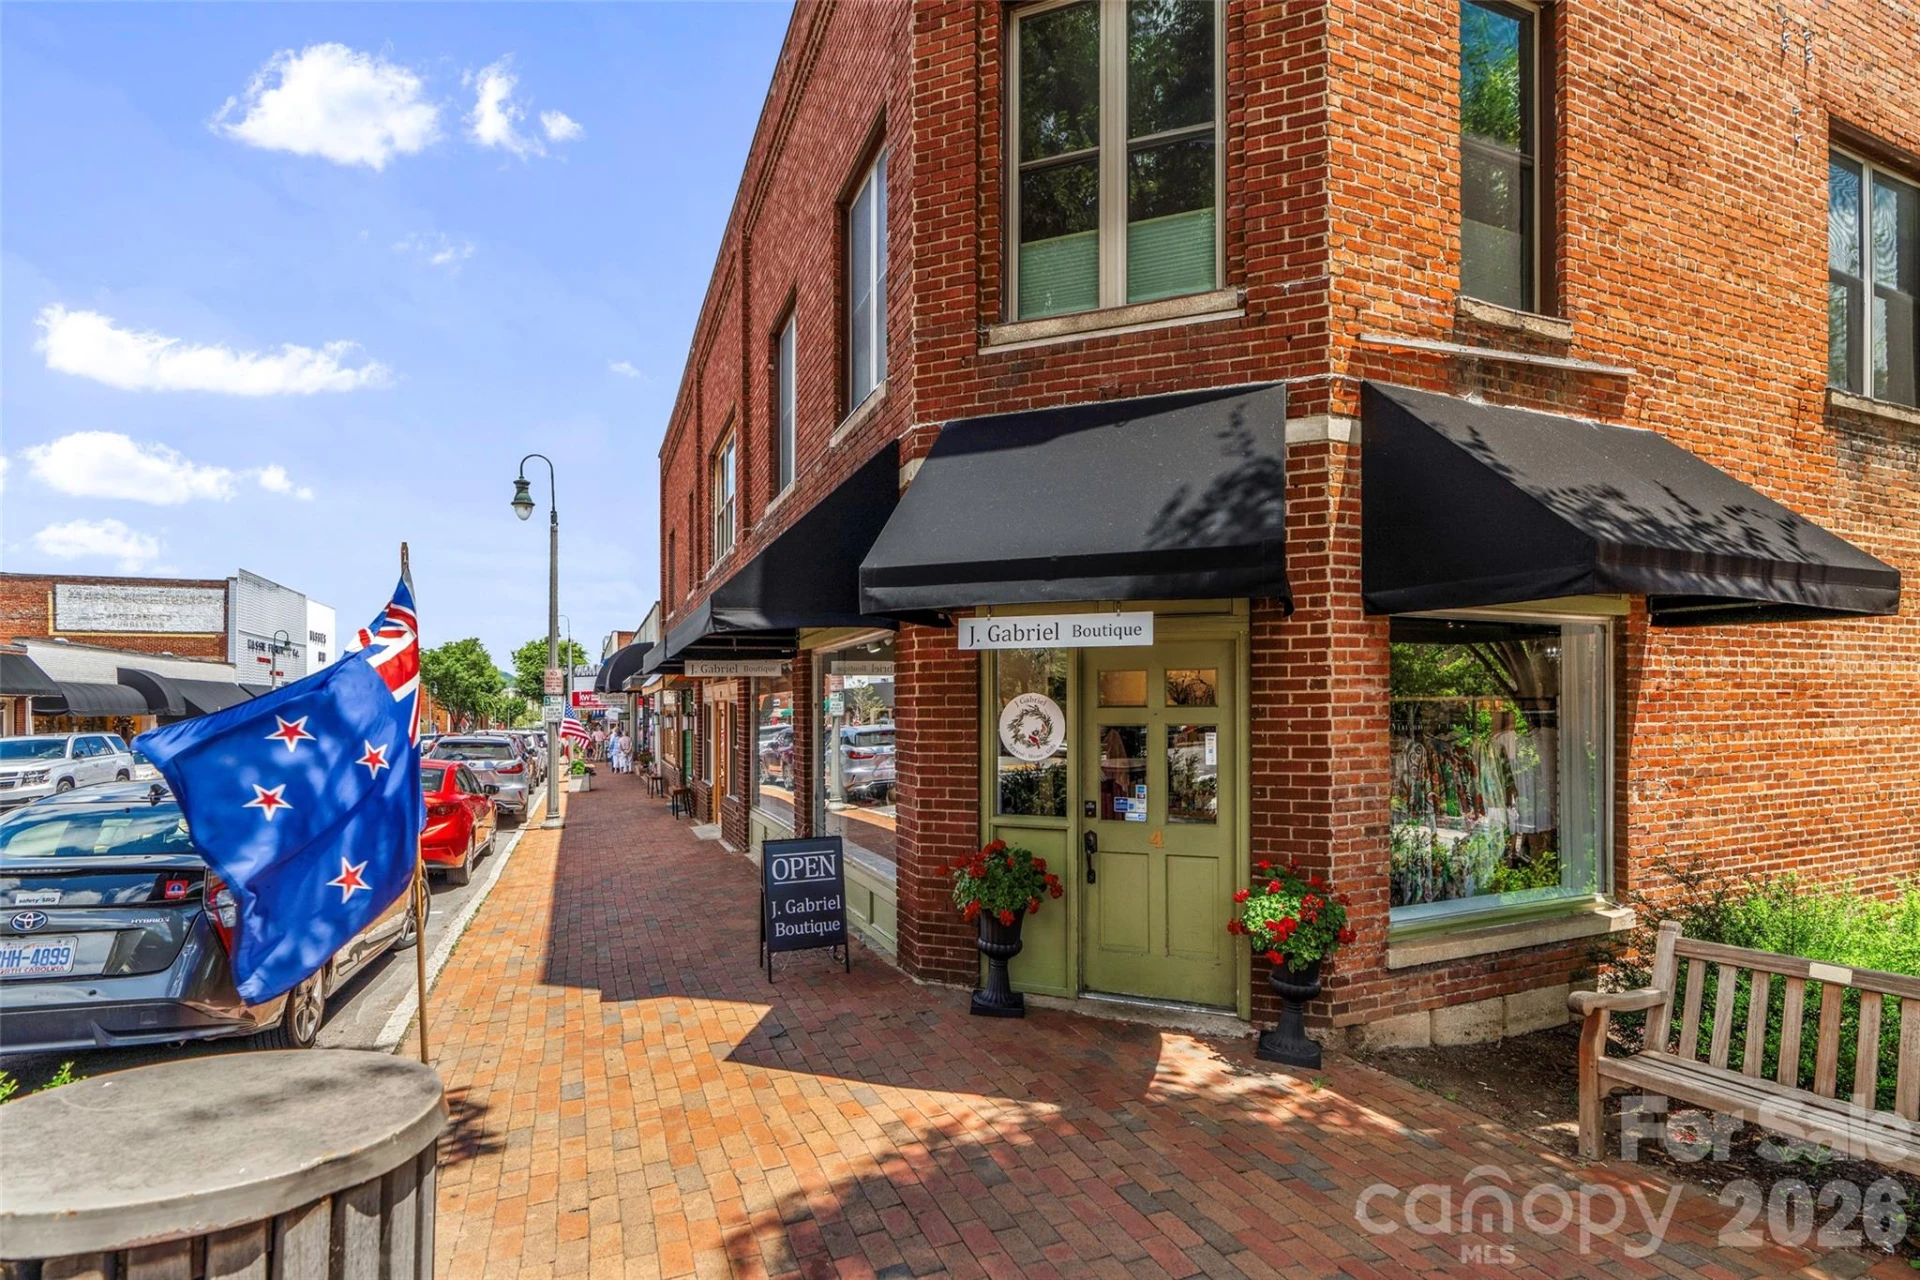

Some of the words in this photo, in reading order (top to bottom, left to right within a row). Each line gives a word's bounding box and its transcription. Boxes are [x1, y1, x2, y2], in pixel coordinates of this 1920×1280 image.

[969, 625, 981, 648] J.
[987, 622, 1060, 643] Gabriel
[1071, 623, 1143, 641] Boutique
[690, 664, 698, 675] J.
[700, 663, 738, 674] Gabriel
[743, 665, 777, 674] Boutique
[1020, 695, 1047, 706] Gabriel
[771, 854, 837, 881] OPEN
[771, 900, 782, 919] J.
[785, 894, 841, 914] Gabriel
[775, 919, 841, 938] Boutique
[0, 947, 71, 968] HH-4899
[24, 966, 65, 974] CAROLINA
